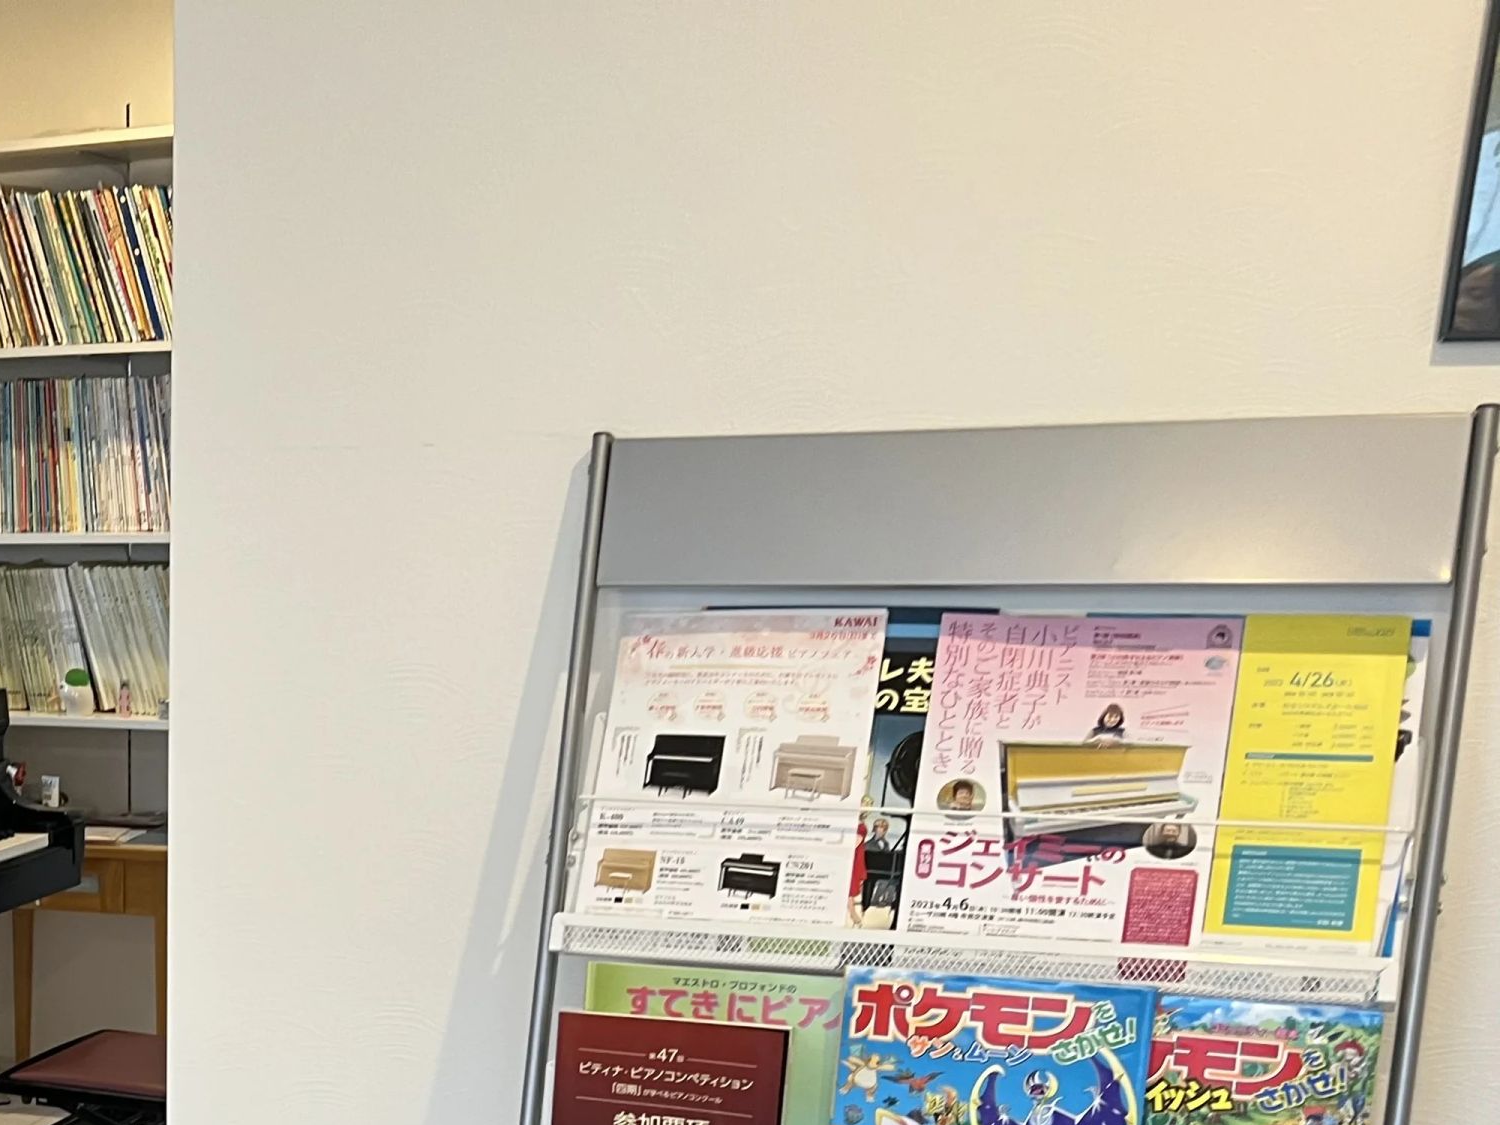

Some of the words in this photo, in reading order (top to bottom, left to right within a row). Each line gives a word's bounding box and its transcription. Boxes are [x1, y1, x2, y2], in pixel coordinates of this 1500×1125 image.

[834, 616, 878, 628] KAWAI
[933, 620, 973, 774] 特別なひととき
[957, 621, 998, 775] そのご家族に贈る
[995, 622, 1027, 729] 自閉症者と
[1021, 624, 1057, 729] 小川典子が
[1054, 625, 1081, 705] ピアニスト
[1290, 671, 1334, 688] 4/26
[935, 862, 1106, 900] コンサート
[672, 976, 798, 994] マエストロ・プロフォンドの
[852, 982, 1096, 1050] ポケモン
[578, 1061, 754, 1091] ピティナ・ピアノコンペティション
